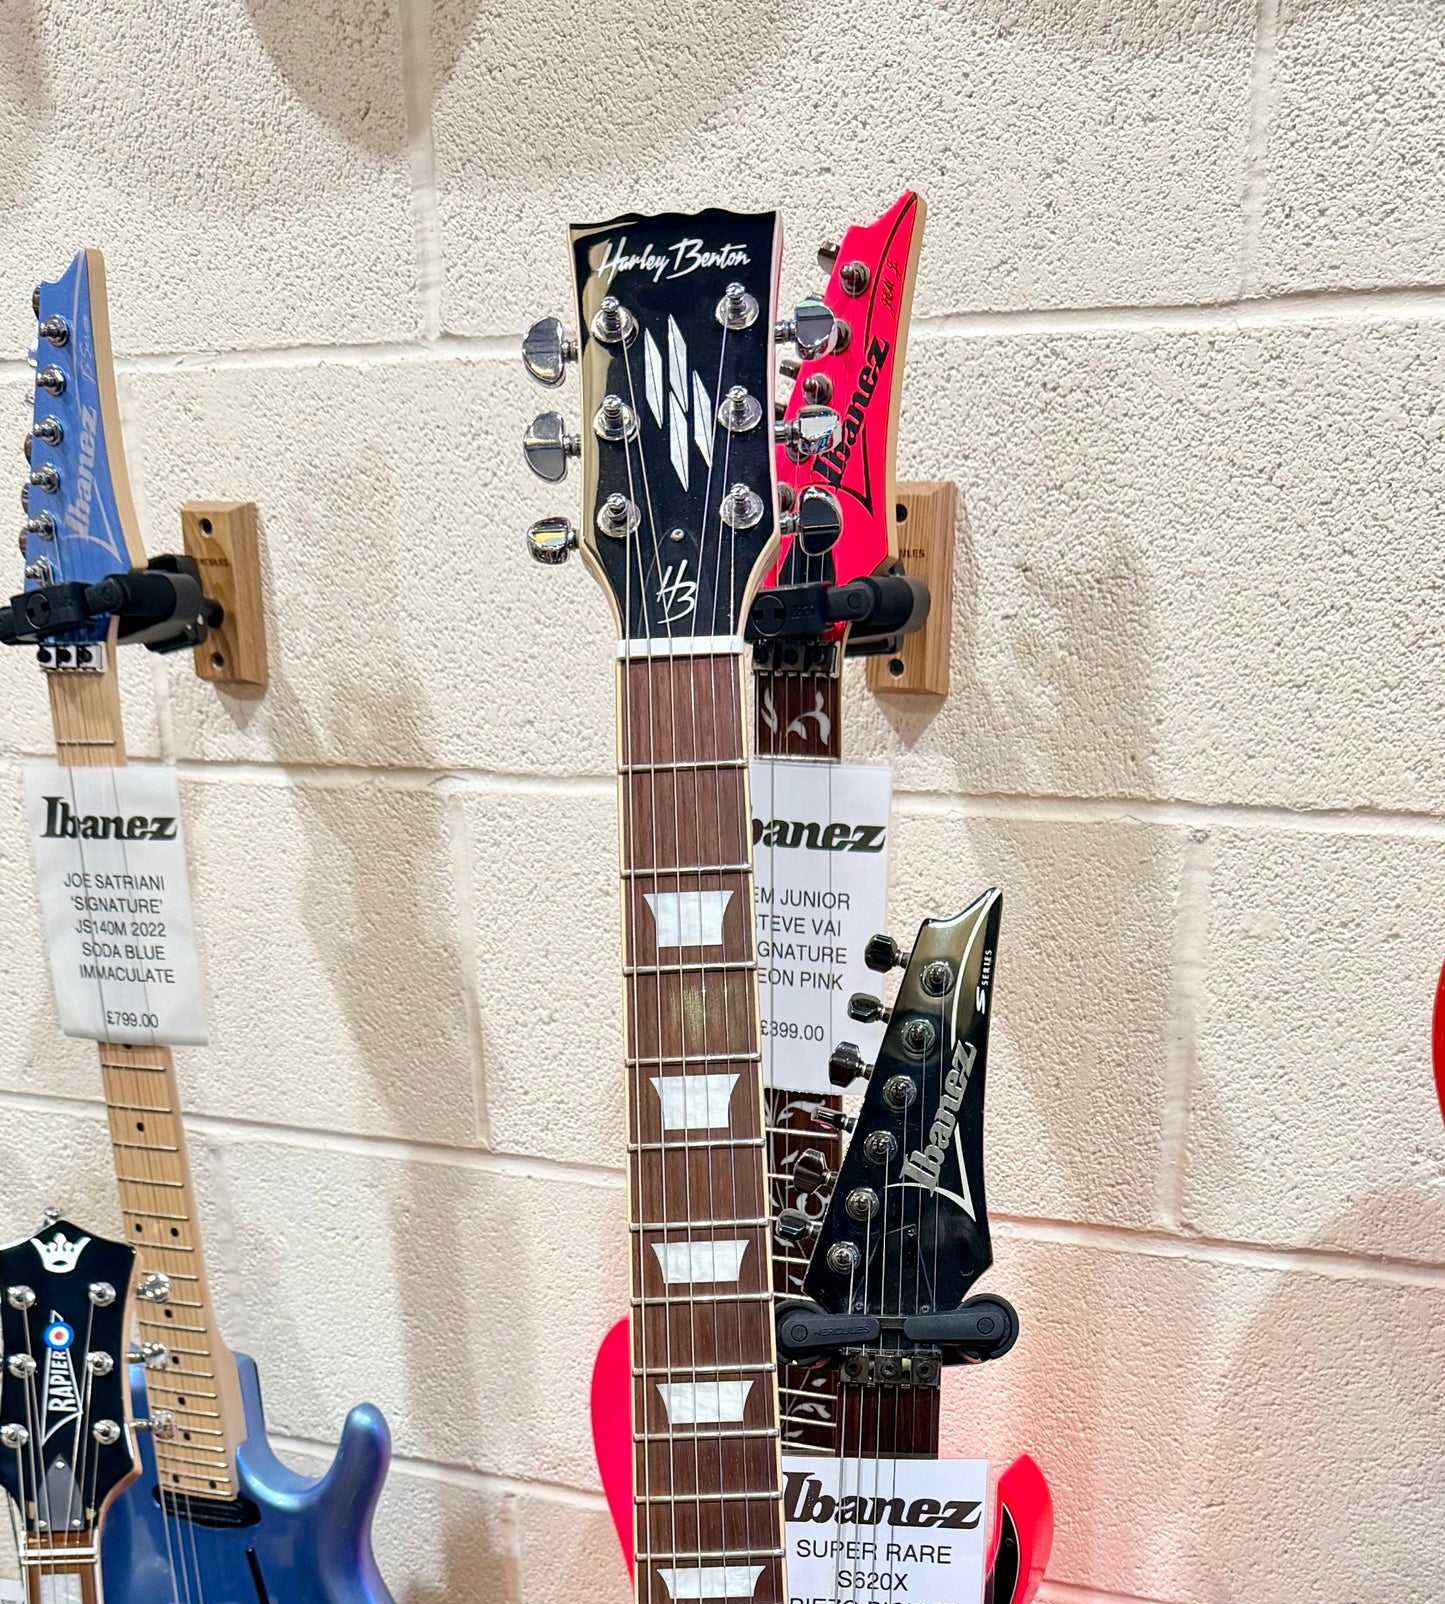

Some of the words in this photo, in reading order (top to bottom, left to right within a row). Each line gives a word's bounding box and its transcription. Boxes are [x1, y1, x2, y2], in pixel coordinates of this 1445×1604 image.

[596, 236, 670, 284] Harley
[666, 238, 751, 280] Benton
[813, 333, 890, 489] Ibanez
[62, 407, 98, 542] Ibanez
[899, 548, 926, 559] ULES
[39, 795, 178, 842] Ibanez
[752, 818, 886, 854] anez
[64, 873, 91, 889] JOE
[94, 874, 165, 892] SATRIANI
[755, 887, 775, 905] EM
[780, 889, 850, 911] JUNIOR
[75, 920, 127, 937] JS140M
[131, 921, 166, 937] 2022
[756, 914, 805, 934] TEVE
[812, 918, 841, 937] VAI
[82, 943, 122, 959] SODA
[126, 944, 166, 961] BLUE
[757, 941, 847, 964] GNATURE
[79, 965, 175, 984] IMMACULATE
[758, 967, 794, 986] EON
[800, 971, 843, 990] PINK
[975, 985, 987, 1015] S
[982, 948, 994, 987] SERIES
[106, 1011, 159, 1029] £799.00
[899, 1039, 978, 1198] Ibanez
[48, 1351, 77, 1412] RAPIER
[783, 1471, 982, 1530] Ibanez
[796, 1539, 877, 1561] SUPER
[886, 1543, 952, 1564] RARE
[837, 1570, 908, 1591] S620X
